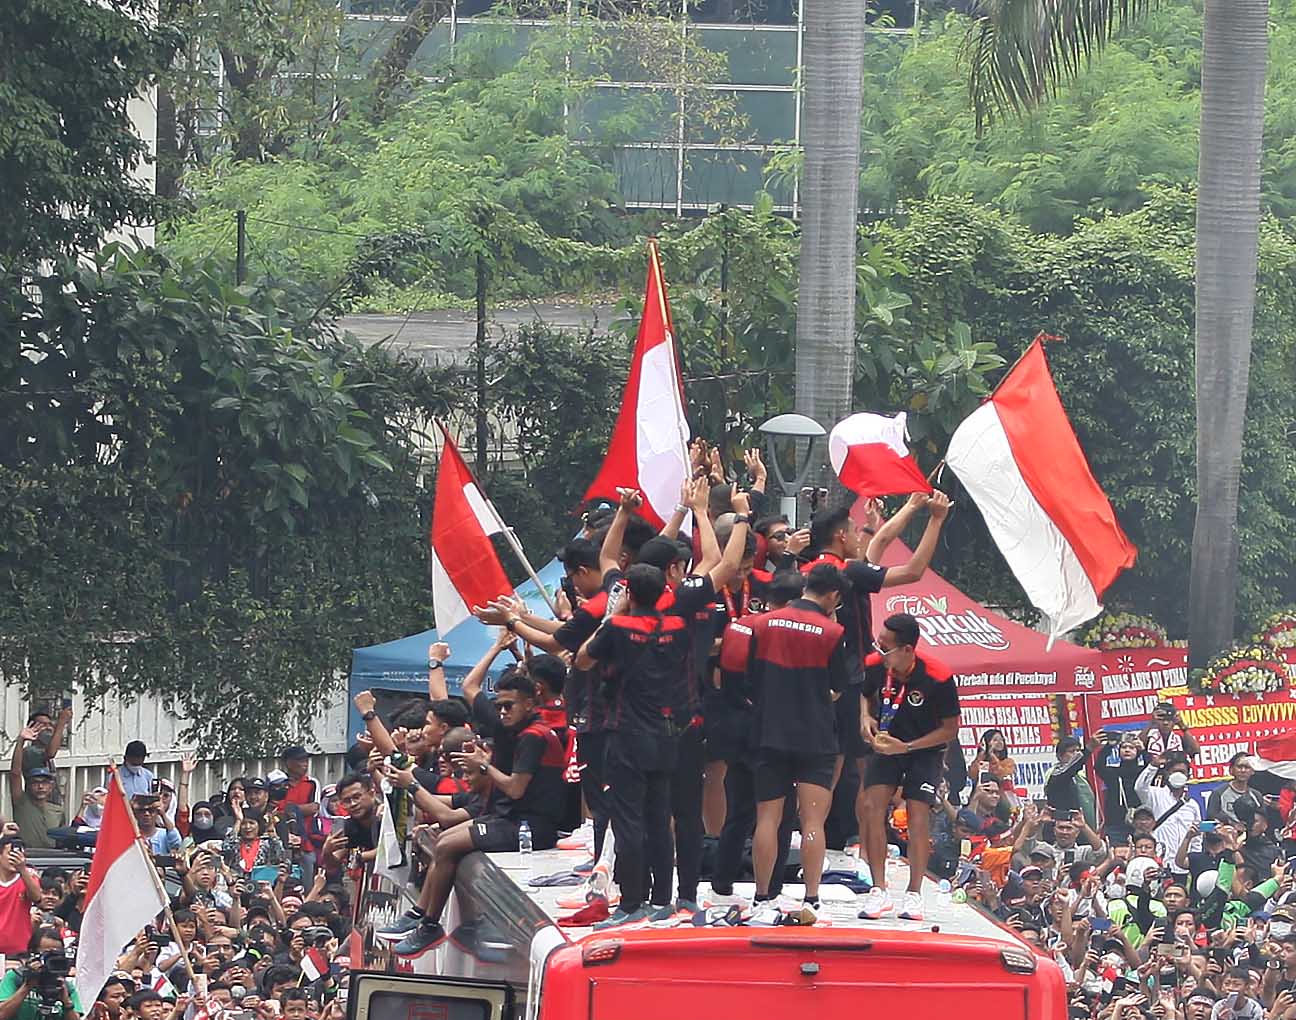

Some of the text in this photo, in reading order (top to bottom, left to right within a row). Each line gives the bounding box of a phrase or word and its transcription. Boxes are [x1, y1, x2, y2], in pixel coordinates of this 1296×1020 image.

[886, 594, 929, 615] Teh
[767, 618, 824, 636] INDONESIA
[959, 672, 989, 687] Terbaik
[1005, 672, 1015, 686] di
[996, 706, 1020, 725] BISA
[1020, 705, 1051, 724] JUARA
